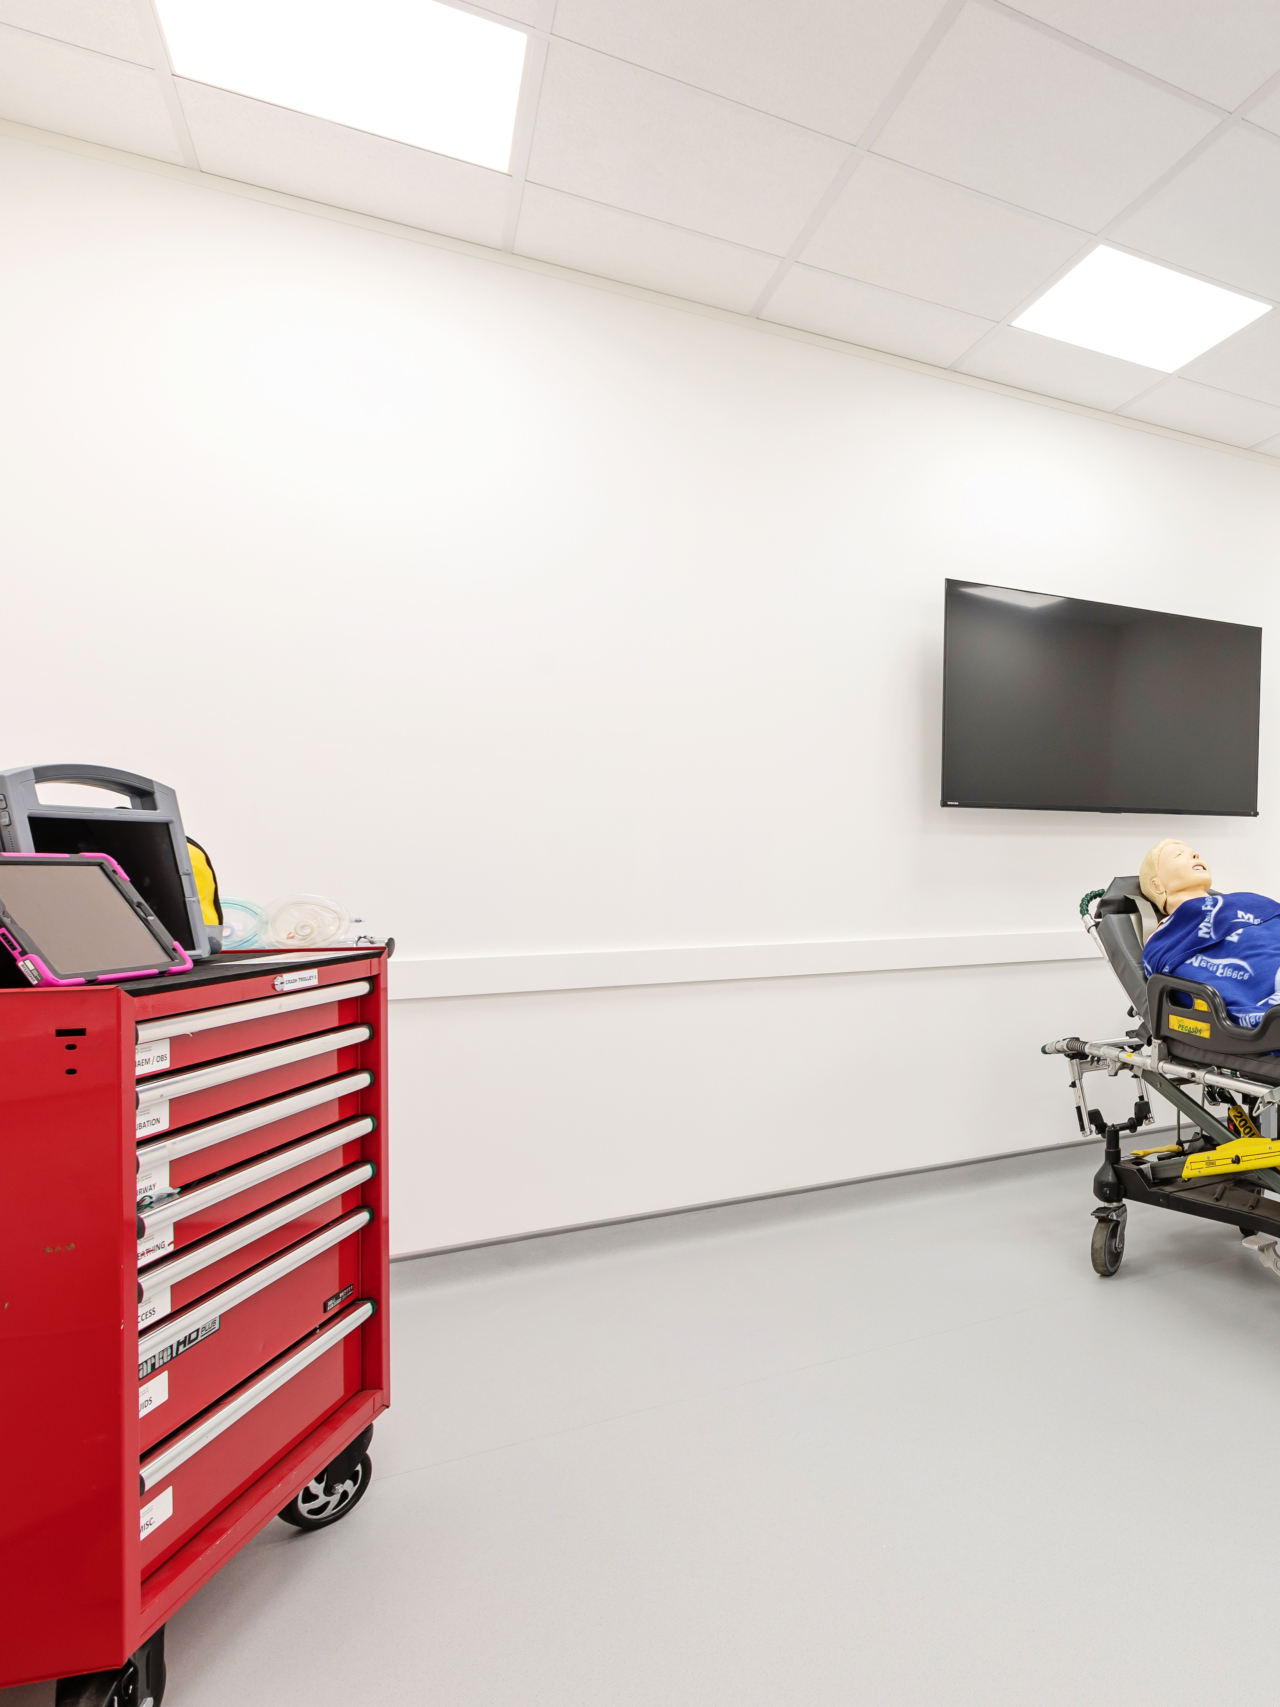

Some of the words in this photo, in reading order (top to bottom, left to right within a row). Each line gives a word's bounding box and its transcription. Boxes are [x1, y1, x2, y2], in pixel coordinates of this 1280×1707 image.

[1177, 1023, 1202, 1036] PEGASUS
[156, 1053, 168, 1063] OBS
[200, 1318, 217, 1335] PLUS
